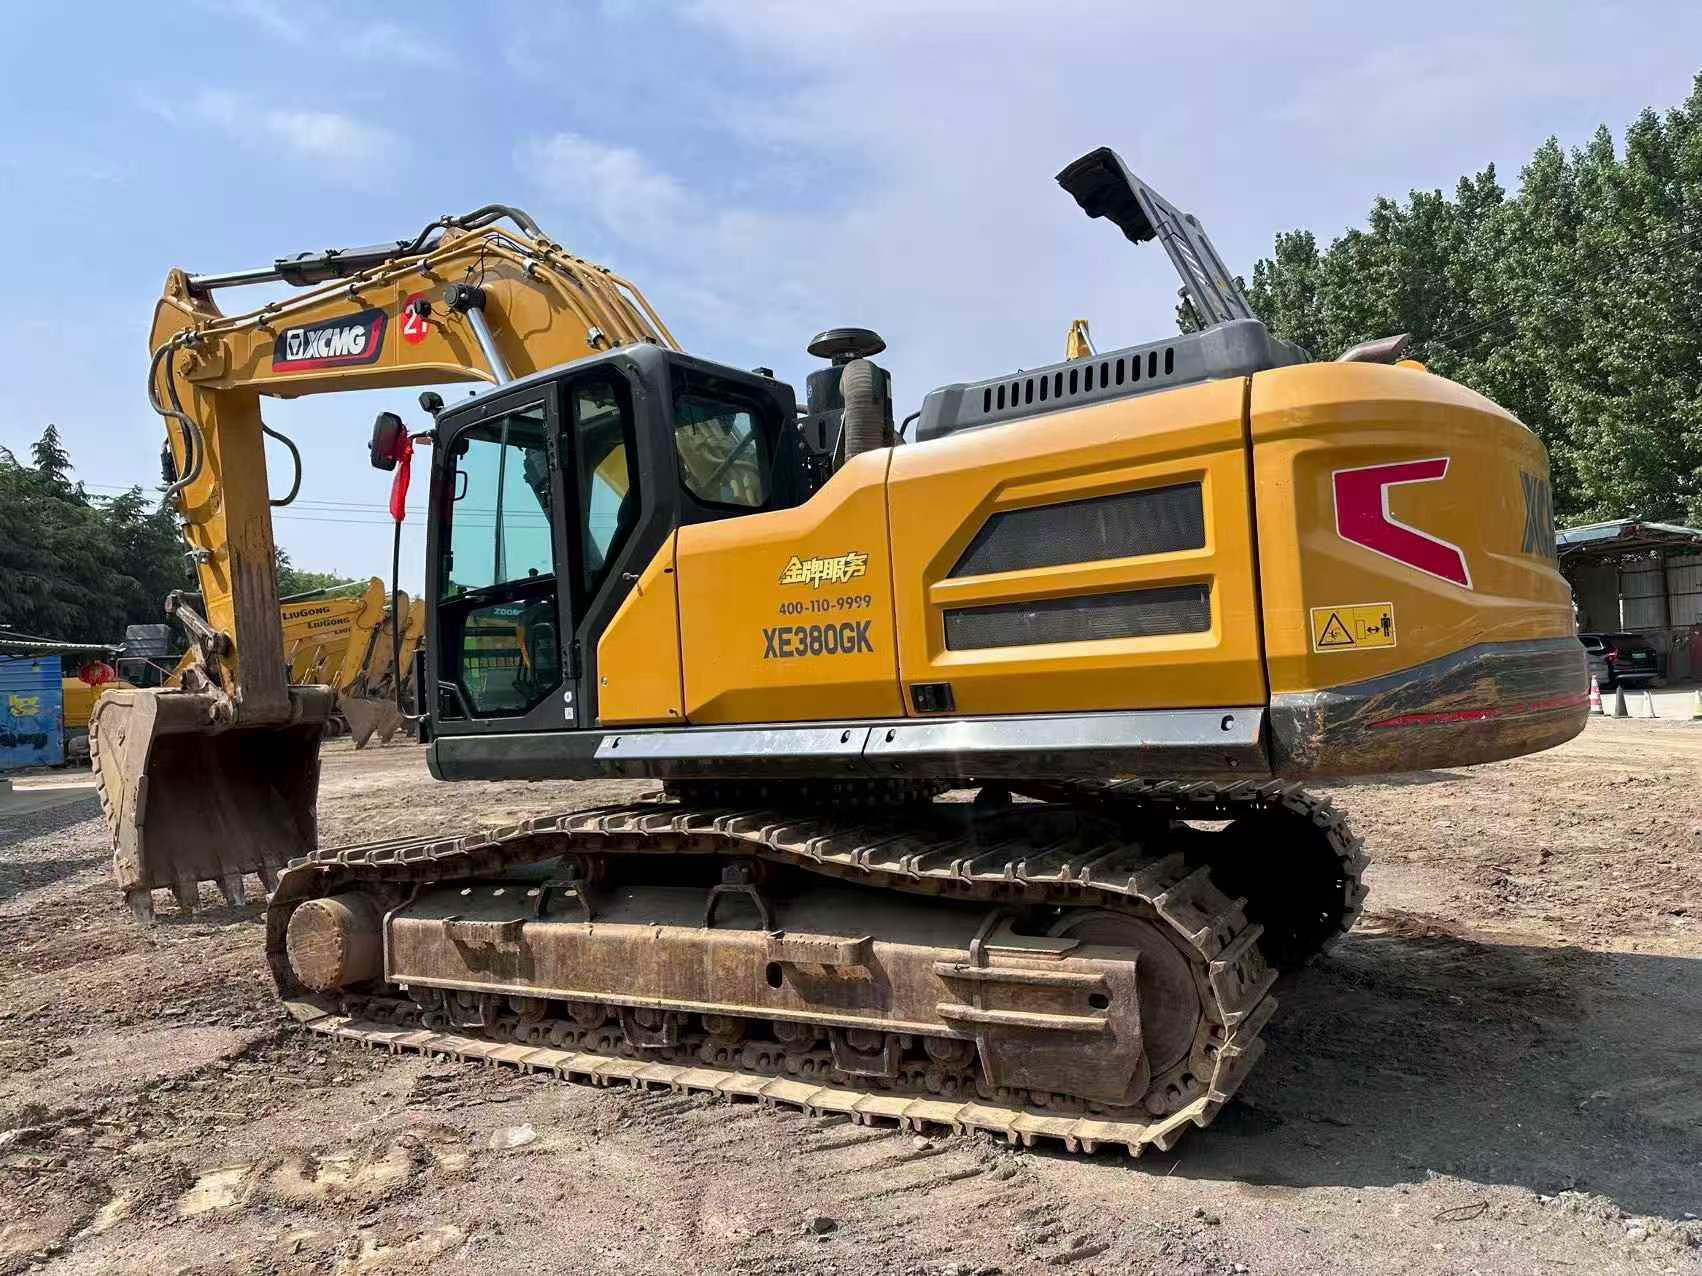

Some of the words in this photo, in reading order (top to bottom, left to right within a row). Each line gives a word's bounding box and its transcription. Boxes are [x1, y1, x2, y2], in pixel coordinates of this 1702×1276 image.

[303, 324, 366, 359] XCMG
[779, 551, 868, 590] 金牌服务
[779, 594, 872, 615] 400-110-9999
[762, 620, 874, 659] XE380GK
